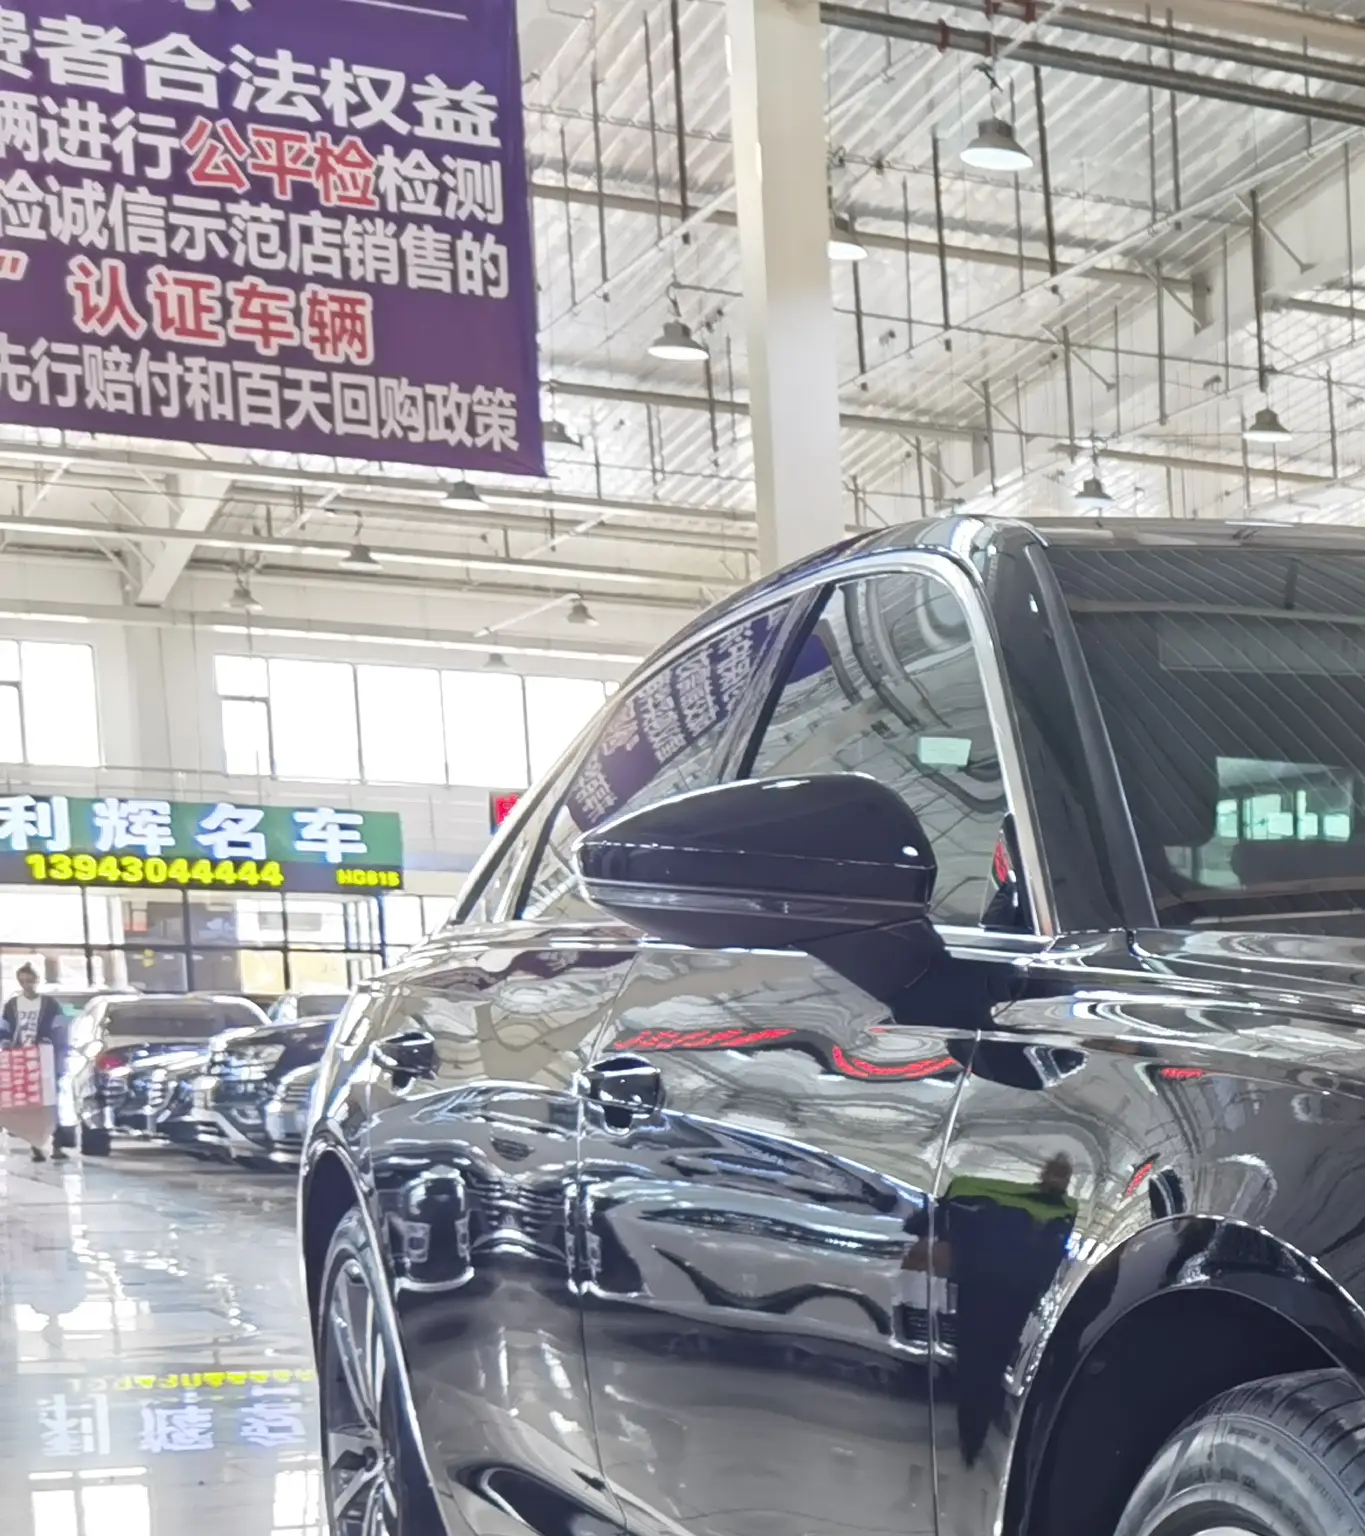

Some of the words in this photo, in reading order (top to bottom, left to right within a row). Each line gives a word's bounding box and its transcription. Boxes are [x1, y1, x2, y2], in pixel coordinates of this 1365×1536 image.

[0, 168, 509, 299] 检诚信示范店销售的
[0, 331, 520, 453] 先行赔付和百天回购政策
[0, 796, 368, 864] 利辉名车
[26, 852, 285, 888] 13943044444
